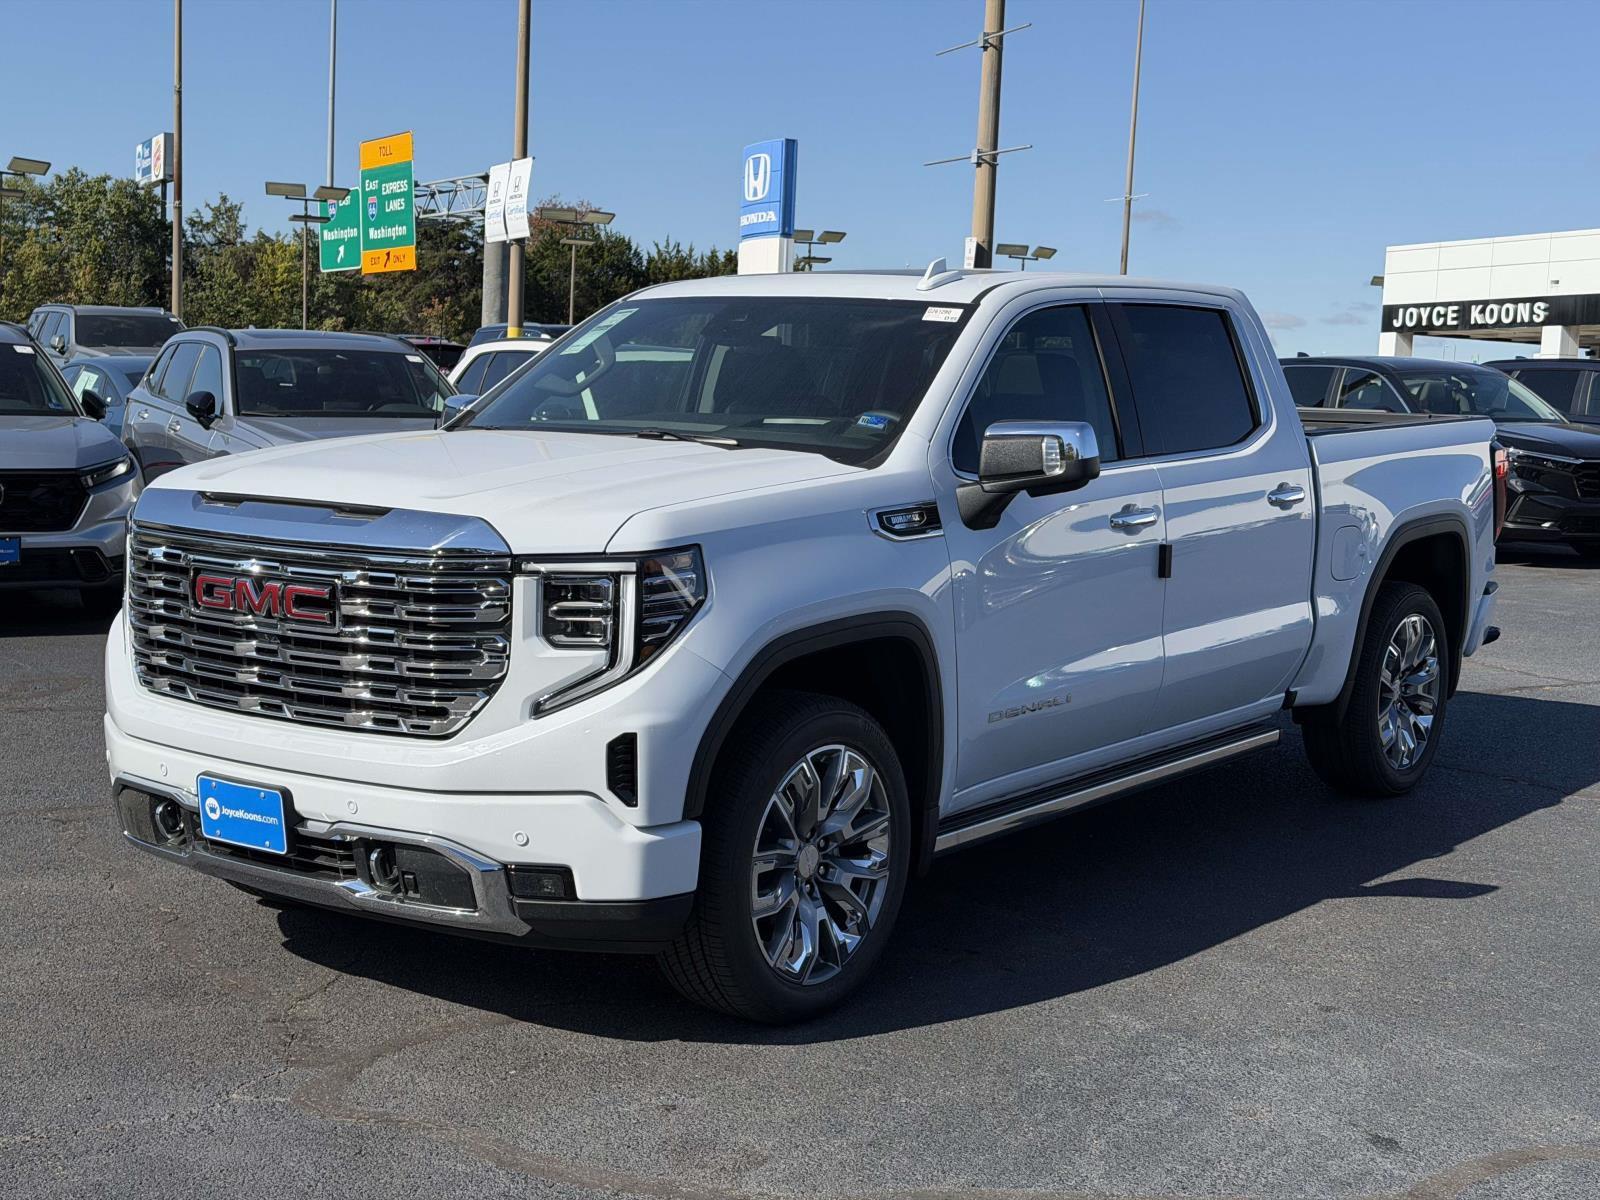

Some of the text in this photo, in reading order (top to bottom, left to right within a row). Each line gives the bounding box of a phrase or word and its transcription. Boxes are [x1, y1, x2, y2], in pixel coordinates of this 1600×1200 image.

[379, 144, 392, 157] TOLL
[365, 179, 378, 191] EAST
[381, 179, 408, 196] EXPRESS
[385, 197, 405, 212] LANES
[740, 210, 777, 226] HONDA
[323, 226, 358, 242] Washington
[368, 224, 407, 240] Washington
[370, 253, 406, 266] EXIT ONLY
[1392, 301, 1550, 328] JOYCE KOONS
[195, 574, 333, 623] GMC
[988, 692, 1072, 723] DENALI
[221, 805, 279, 825] JoyceKoons.com
